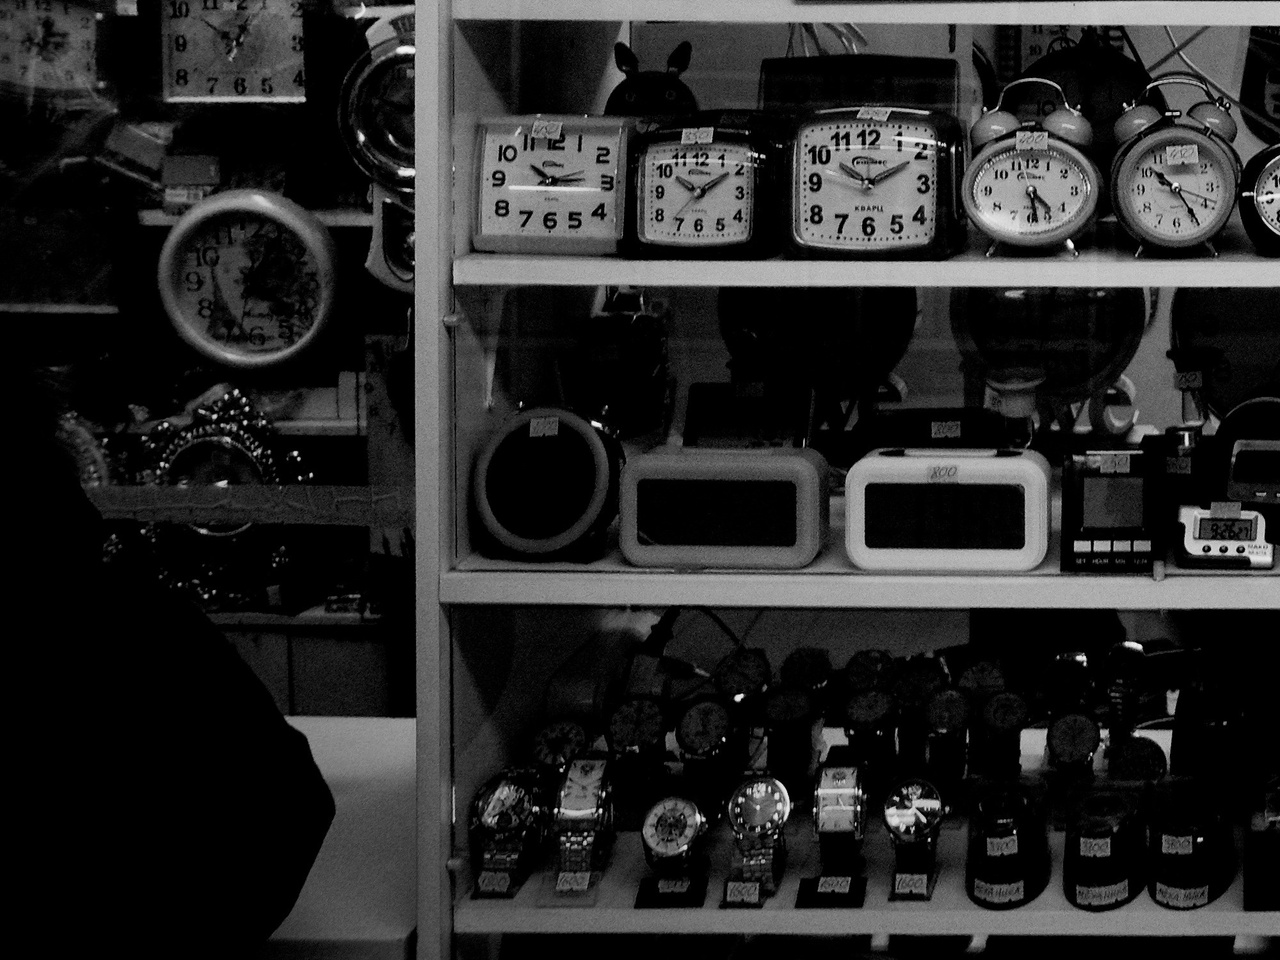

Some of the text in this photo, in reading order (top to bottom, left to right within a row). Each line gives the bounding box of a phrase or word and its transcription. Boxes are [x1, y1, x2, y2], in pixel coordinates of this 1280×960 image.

[577, 134, 582, 152] 1
[831, 132, 851, 151] 11
[857, 129, 881, 150] 12
[895, 132, 903, 152] 1
[498, 145, 518, 162] 10
[596, 147, 611, 164] 2
[808, 145, 831, 165] 10
[914, 142, 928, 160] 2
[492, 170, 506, 187] 9
[656, 164, 673, 178] 10
[735, 164, 745, 176] 2
[602, 175, 614, 191] 3
[809, 173, 822, 192] 9
[917, 174, 930, 194] 3
[655, 186, 665, 199] 9
[735, 187, 745, 200] 3
[494, 200, 510, 217] 8
[591, 203, 607, 221] 4
[655, 209, 665, 223] 8
[733, 209, 743, 222] 4
[810, 205, 823, 225] 8
[912, 206, 927, 225] 4
[519, 210, 534, 228] 7
[542, 212, 557, 230] 6
[568, 212, 583, 229] 5
[675, 218, 684, 232] 7
[694, 218, 703, 232] 6
[716, 218, 725, 231] 5
[835, 214, 849, 234] 7
[861, 217, 876, 236] 6
[890, 214, 904, 233] 5
[931, 466, 957, 480] 800
